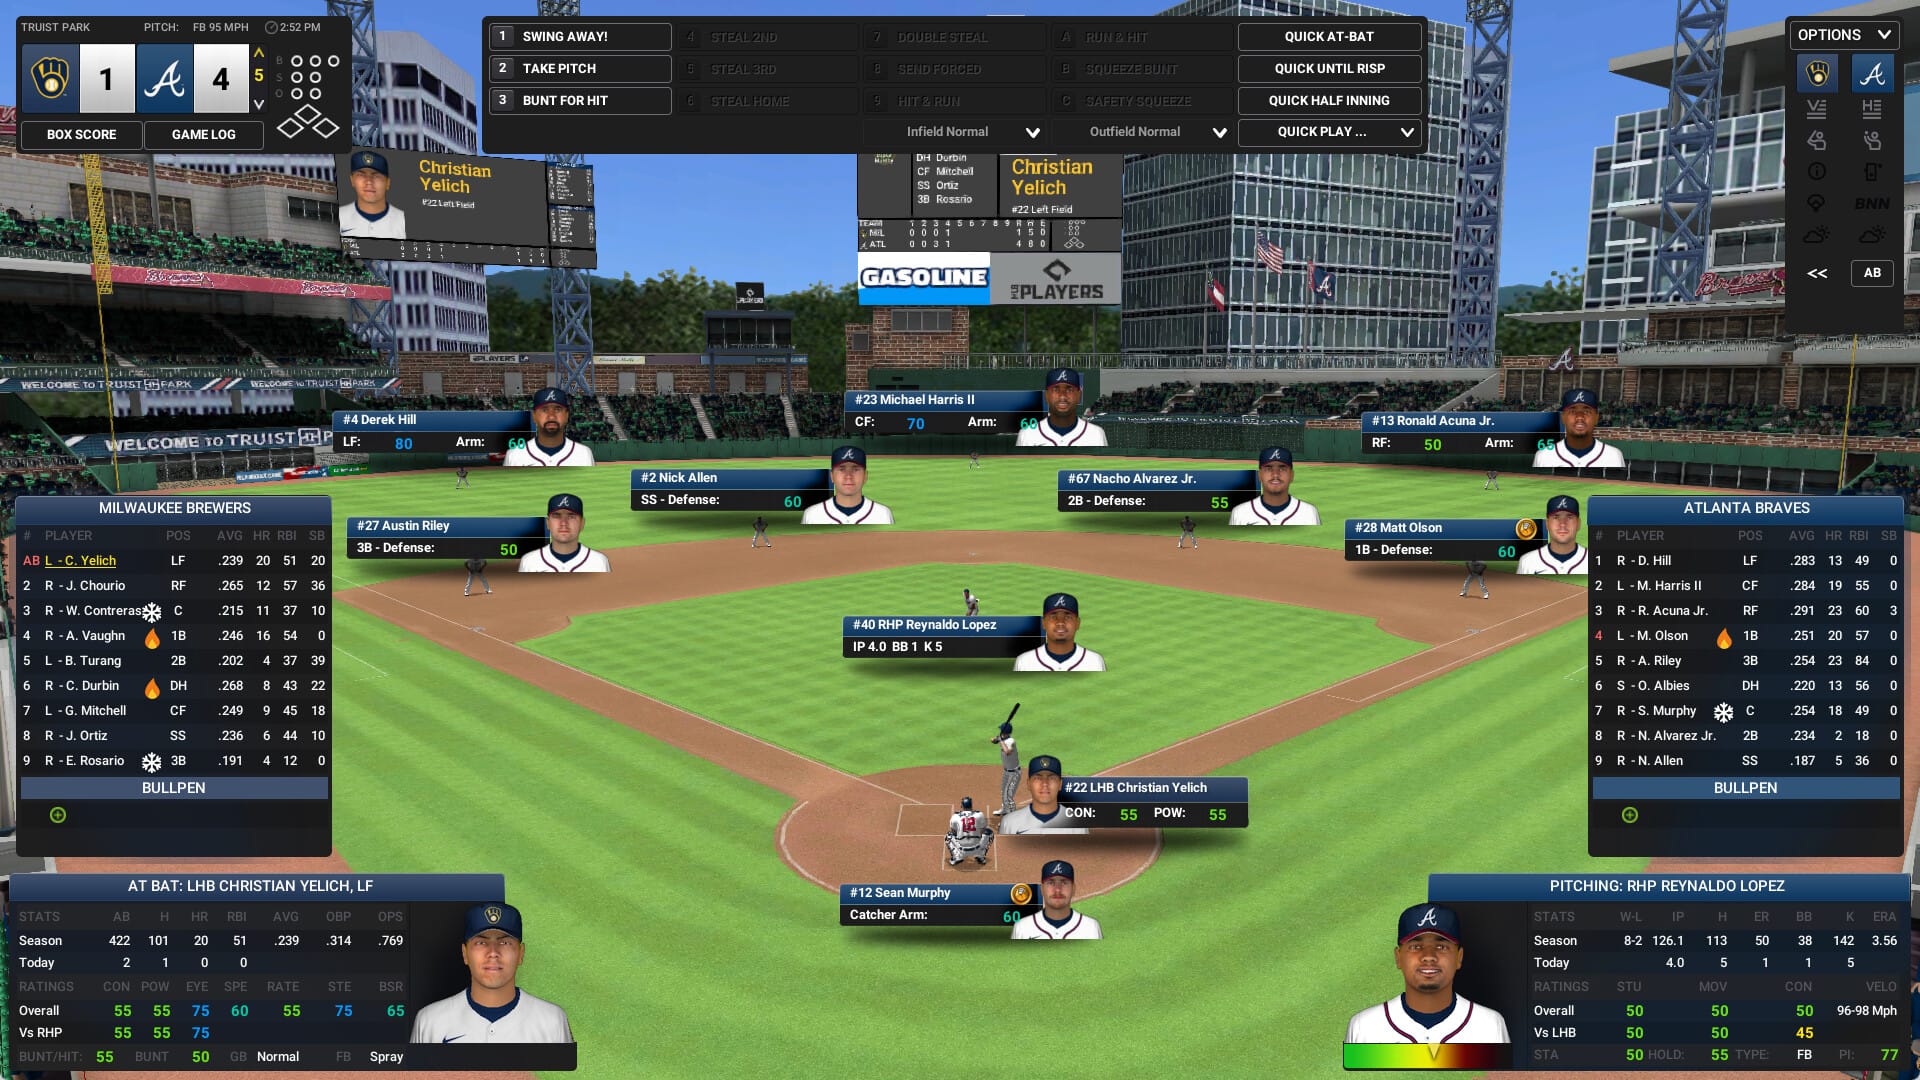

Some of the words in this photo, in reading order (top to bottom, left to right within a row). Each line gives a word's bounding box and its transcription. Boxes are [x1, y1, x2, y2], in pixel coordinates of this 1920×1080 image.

[916, 154, 931, 162] DH
[936, 154, 967, 162] Durbin
[419, 159, 492, 178] Christian
[917, 166, 930, 176] CF
[936, 166, 974, 176] Mitchell
[1012, 158, 1093, 175] Christian
[420, 177, 471, 194] Yelich
[917, 180, 931, 190] SS
[936, 180, 959, 190] Ortiz
[1011, 179, 1067, 196] Yelich
[1011, 205, 1029, 214] #22
[1031, 204, 1049, 214] Left
[1051, 204, 1073, 214] Field
[869, 240, 887, 248] ATL
[860, 268, 989, 289] GASOLINE
[1020, 284, 1104, 300] PLAYERS
[21, 381, 75, 390] WELCOME
[97, 380, 142, 389] TRUIST
[161, 380, 192, 389] PARK
[104, 436, 201, 452] WELCOME
[226, 431, 296, 447] TRUIST
